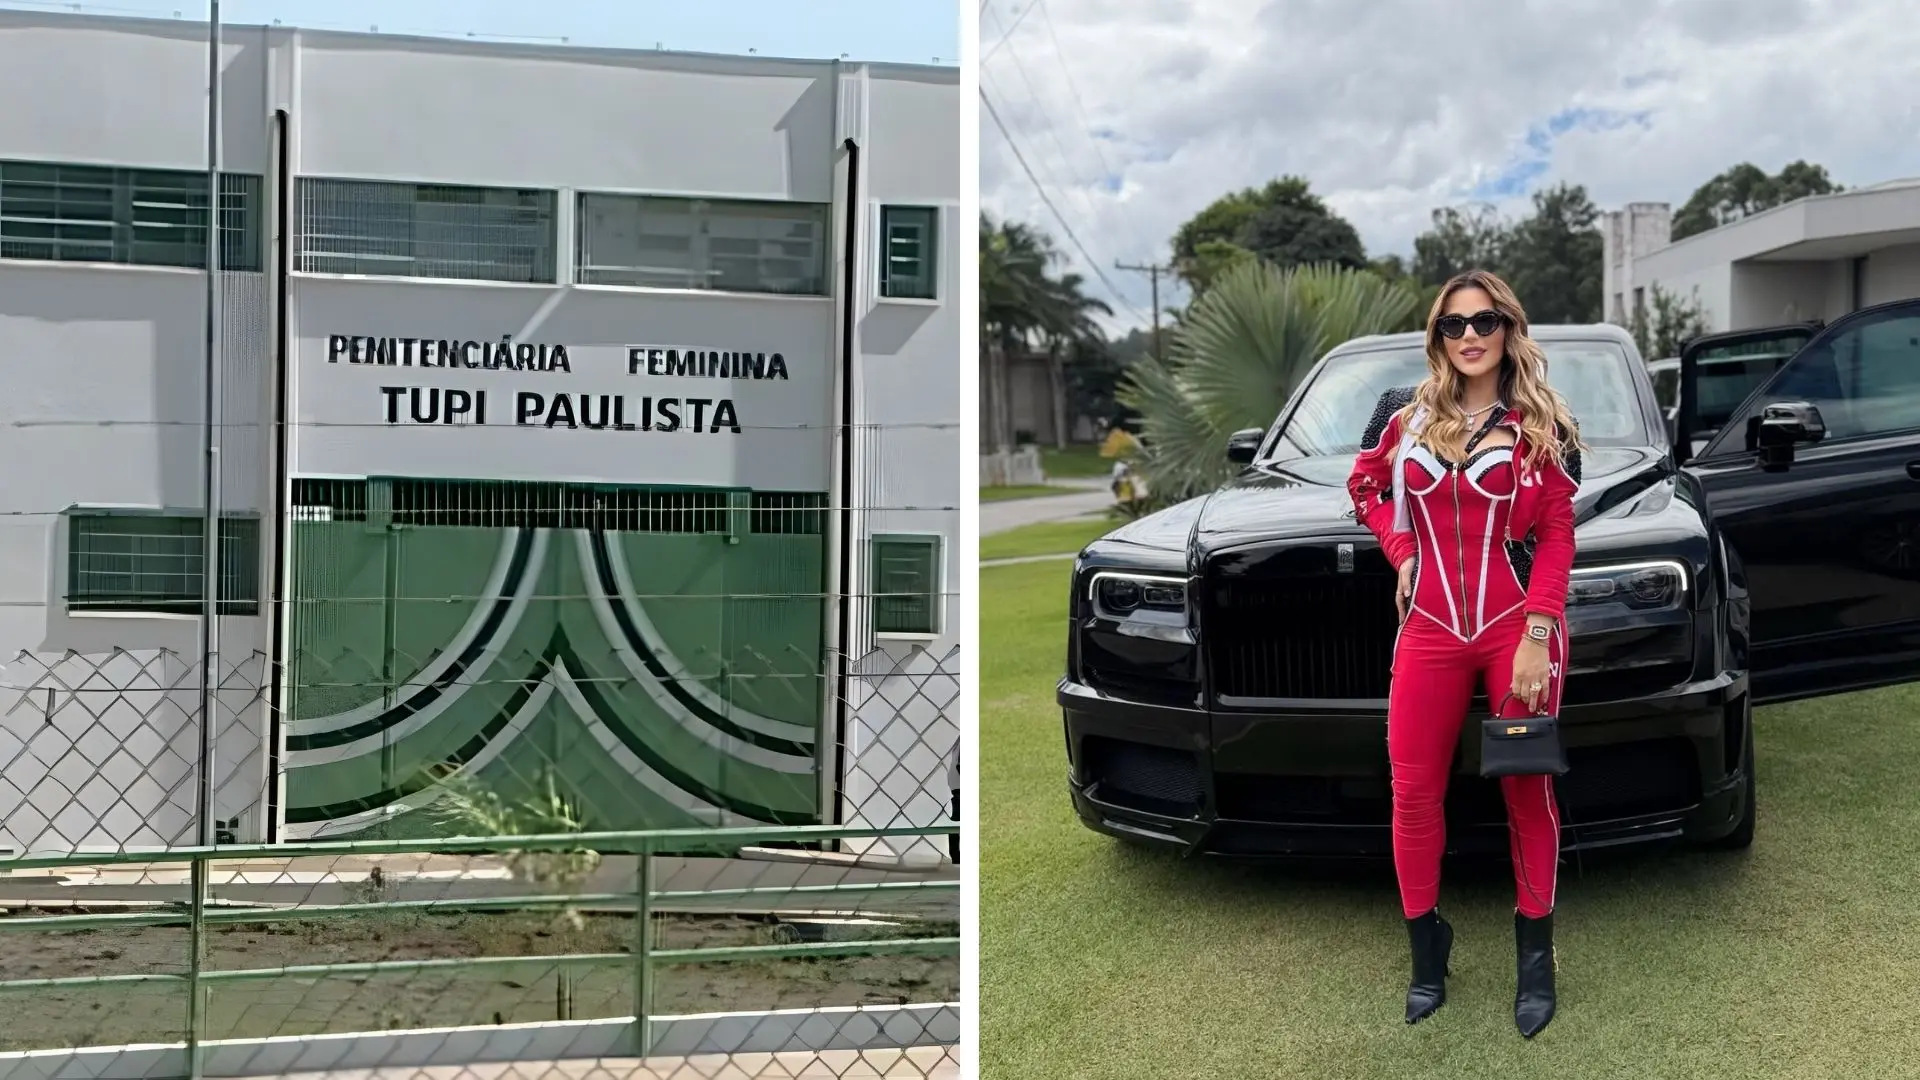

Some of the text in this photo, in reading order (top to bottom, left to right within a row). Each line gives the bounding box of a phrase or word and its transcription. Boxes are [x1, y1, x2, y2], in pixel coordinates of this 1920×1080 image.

[328, 334, 789, 380] PENITENCIÁRIA FEMININA
[380, 386, 742, 434] TUPI PAULISTA
